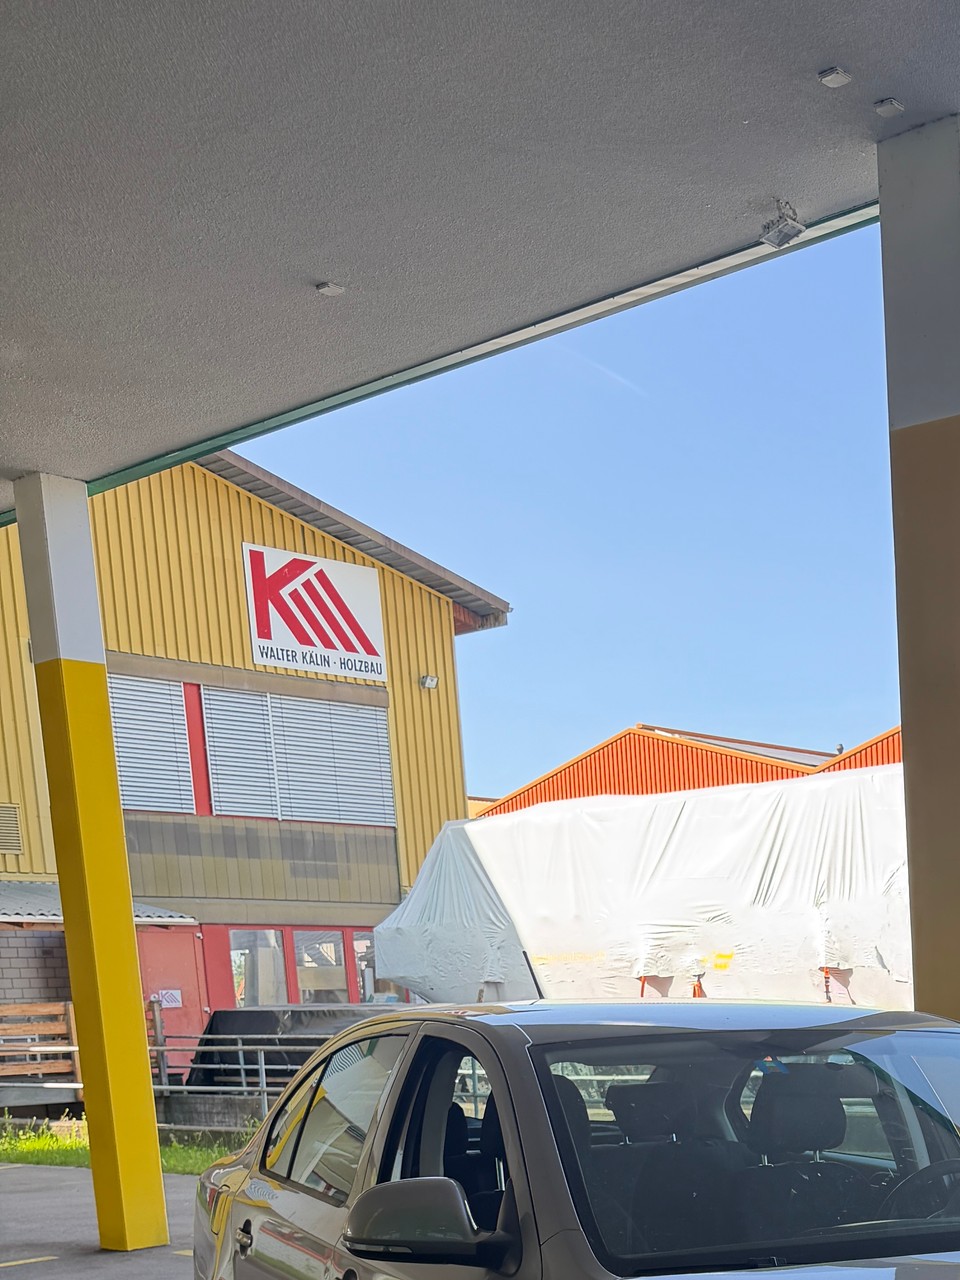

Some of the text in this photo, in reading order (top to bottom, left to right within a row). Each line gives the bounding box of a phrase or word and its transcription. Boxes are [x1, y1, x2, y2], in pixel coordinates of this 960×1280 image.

[258, 645, 383, 676] WALTER KÄLIN HOLZBAU
